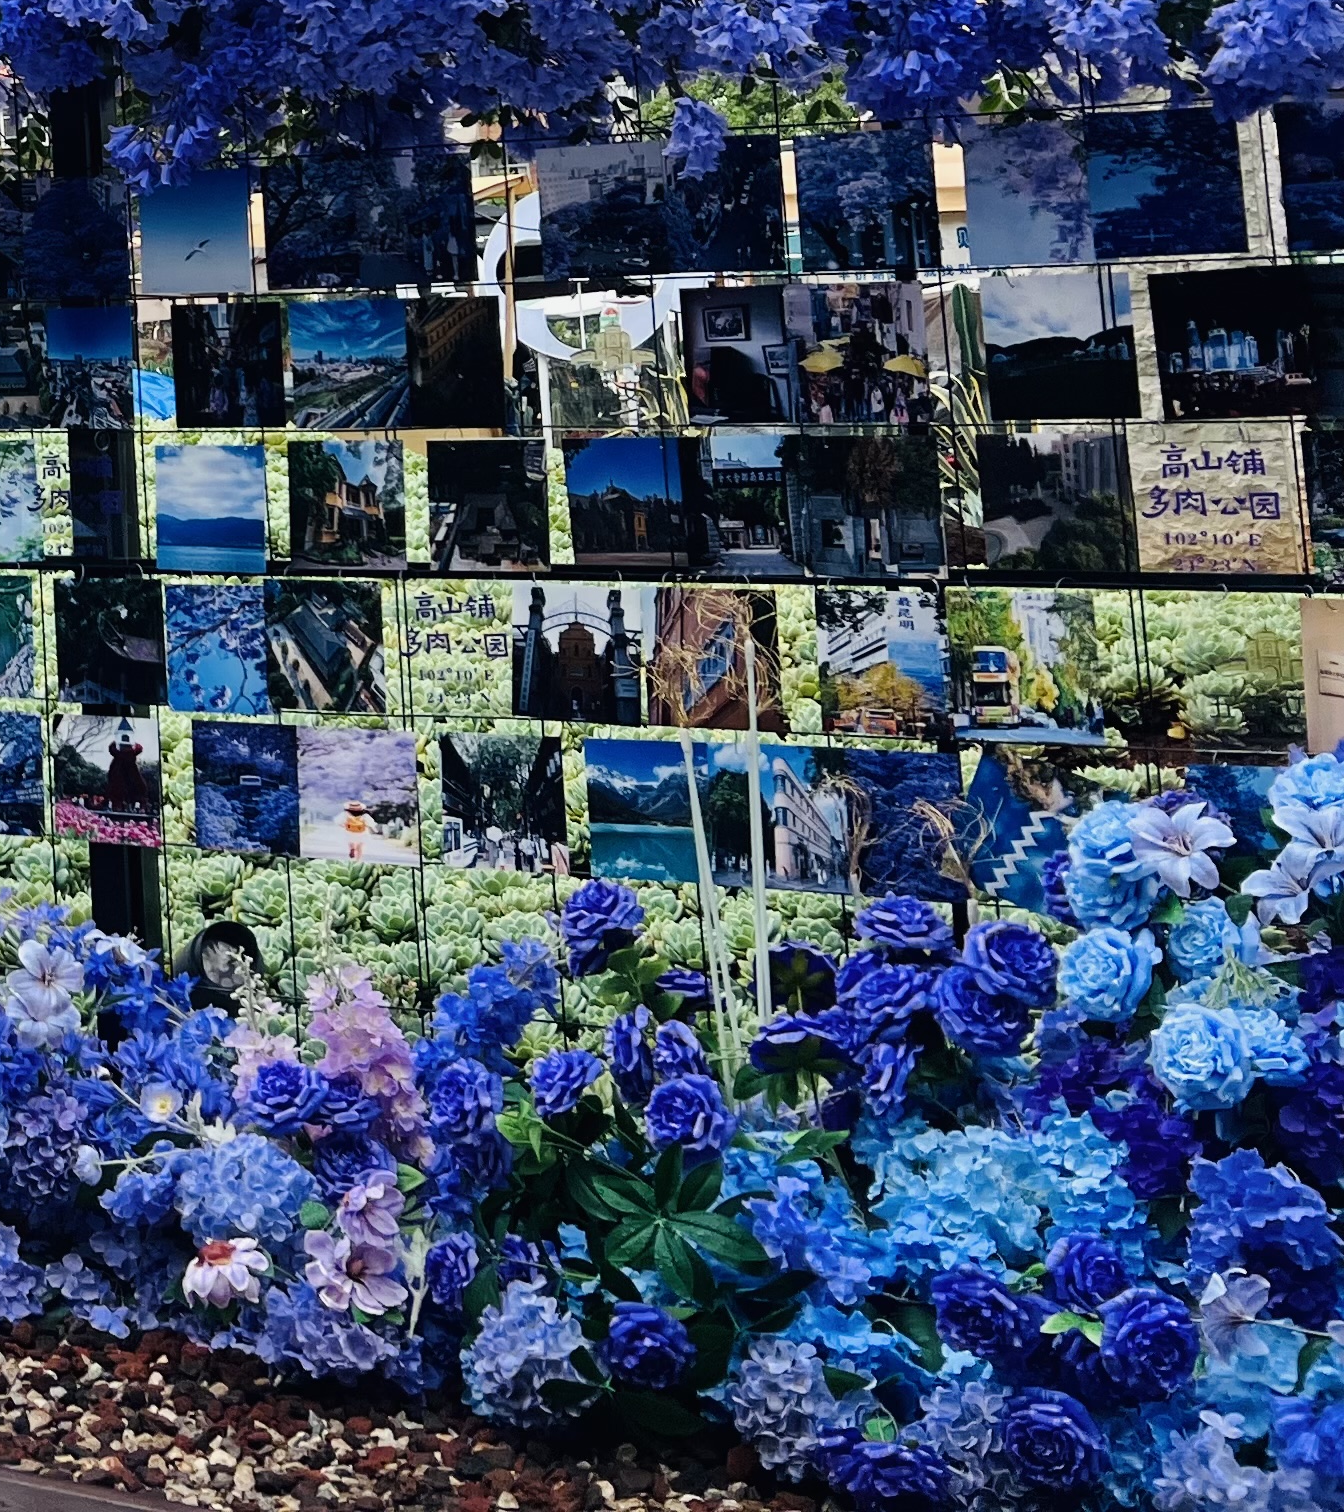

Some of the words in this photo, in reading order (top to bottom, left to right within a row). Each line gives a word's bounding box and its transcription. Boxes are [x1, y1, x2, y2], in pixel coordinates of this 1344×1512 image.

[1160, 443, 1268, 479] 高山铺
[1142, 484, 1281, 521] 多肉公园
[414, 591, 497, 622] 高山铺
[401, 626, 509, 658] 多肉公园
